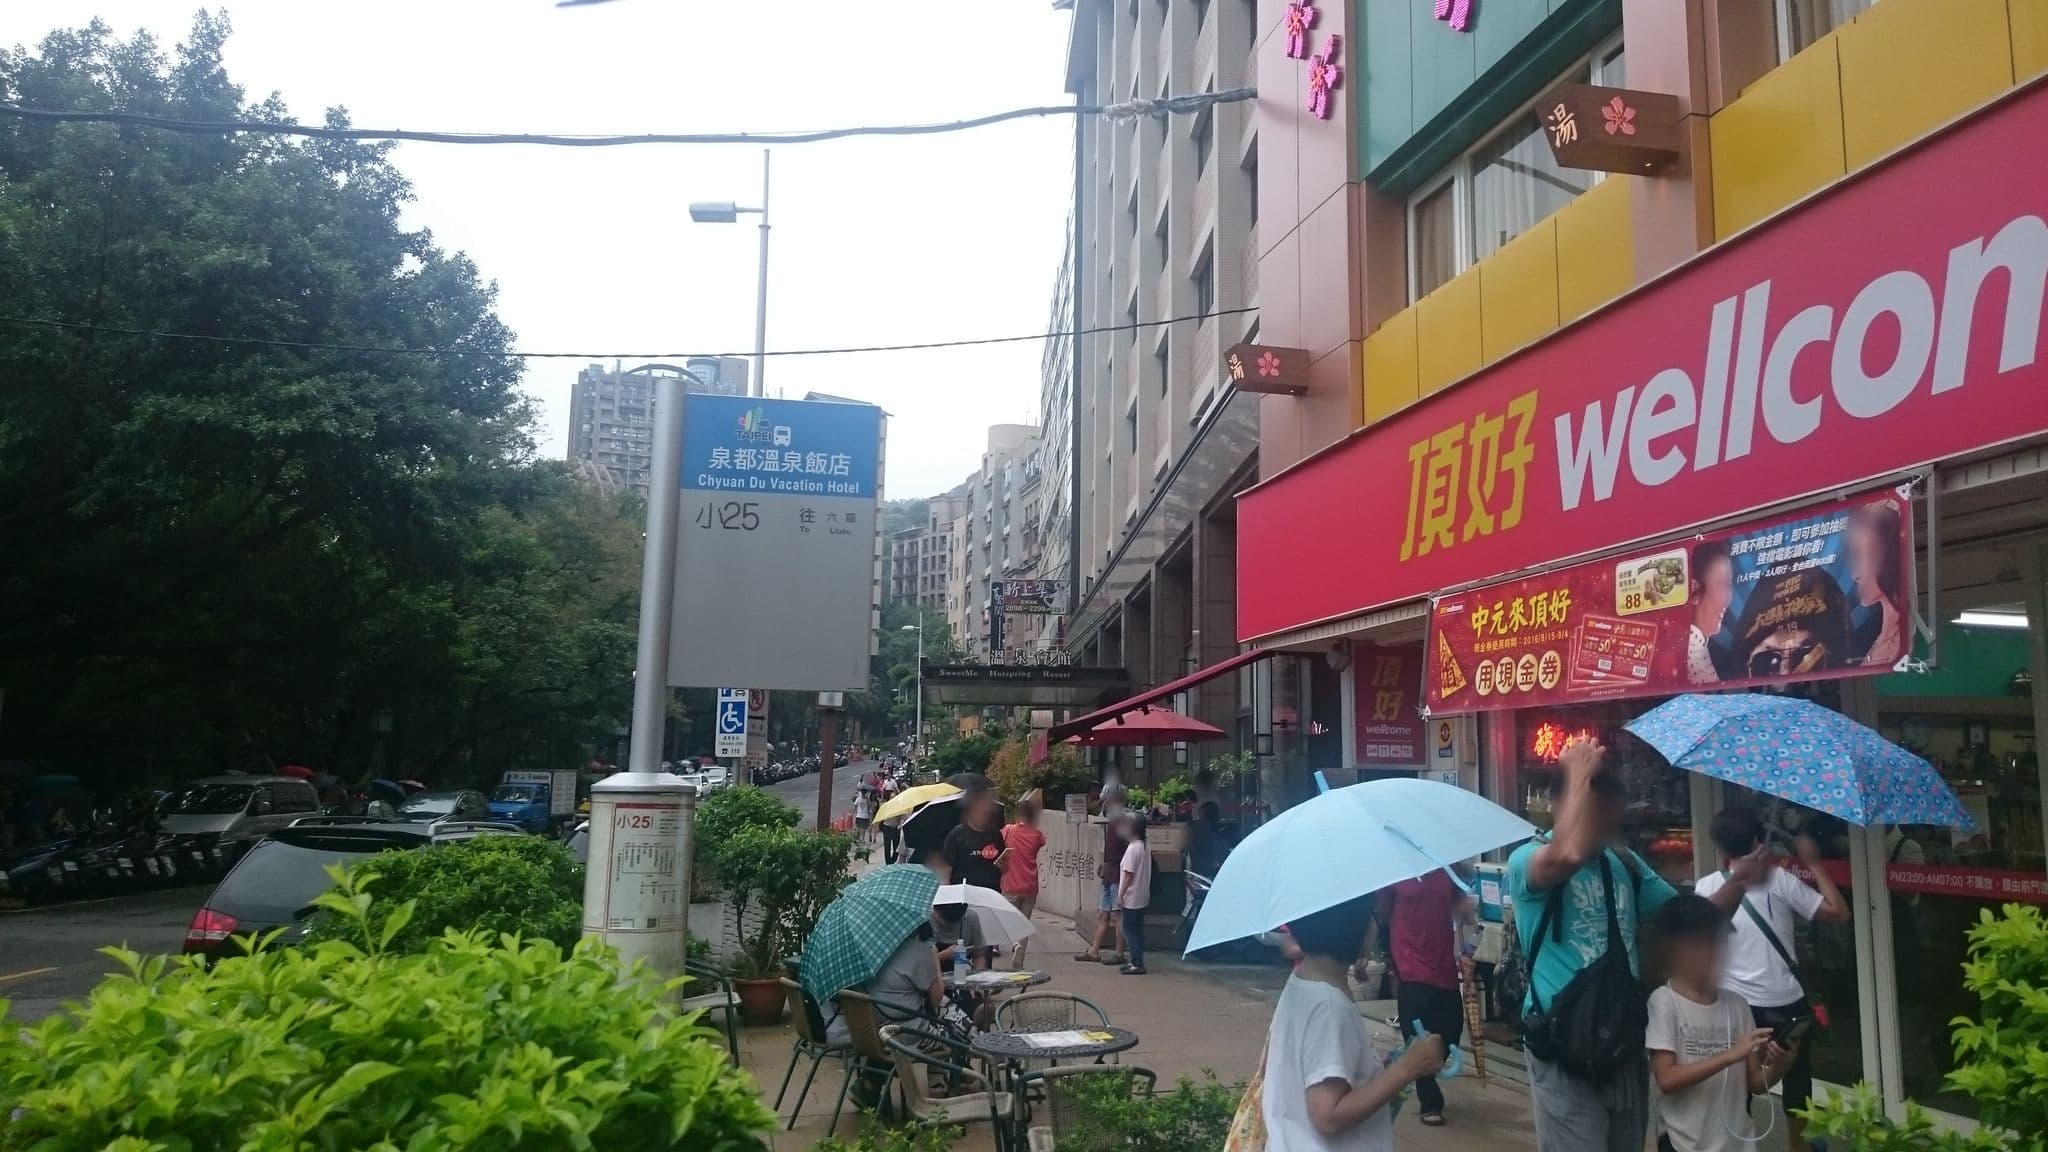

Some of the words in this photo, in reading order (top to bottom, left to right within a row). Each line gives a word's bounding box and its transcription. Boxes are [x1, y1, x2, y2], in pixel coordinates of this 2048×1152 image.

[1548, 103, 1578, 149] 湯
[735, 430, 773, 442] TAIPEI
[708, 446, 852, 476] 泉都溫泉飯店
[1399, 388, 1541, 562] 頂好
[699, 474, 745, 489] Chyuan
[750, 476, 766, 489] Du
[770, 477, 823, 492] Vacation
[828, 481, 859, 494] Hotel
[696, 502, 760, 530] 小25
[800, 508, 816, 523] 往
[800, 525, 810, 533] To
[1472, 588, 1572, 640] 中元來頂好
[1625, 592, 1641, 609] 88
[1477, 654, 1558, 691] 用現金券
[1366, 724, 1412, 735] wellcome
